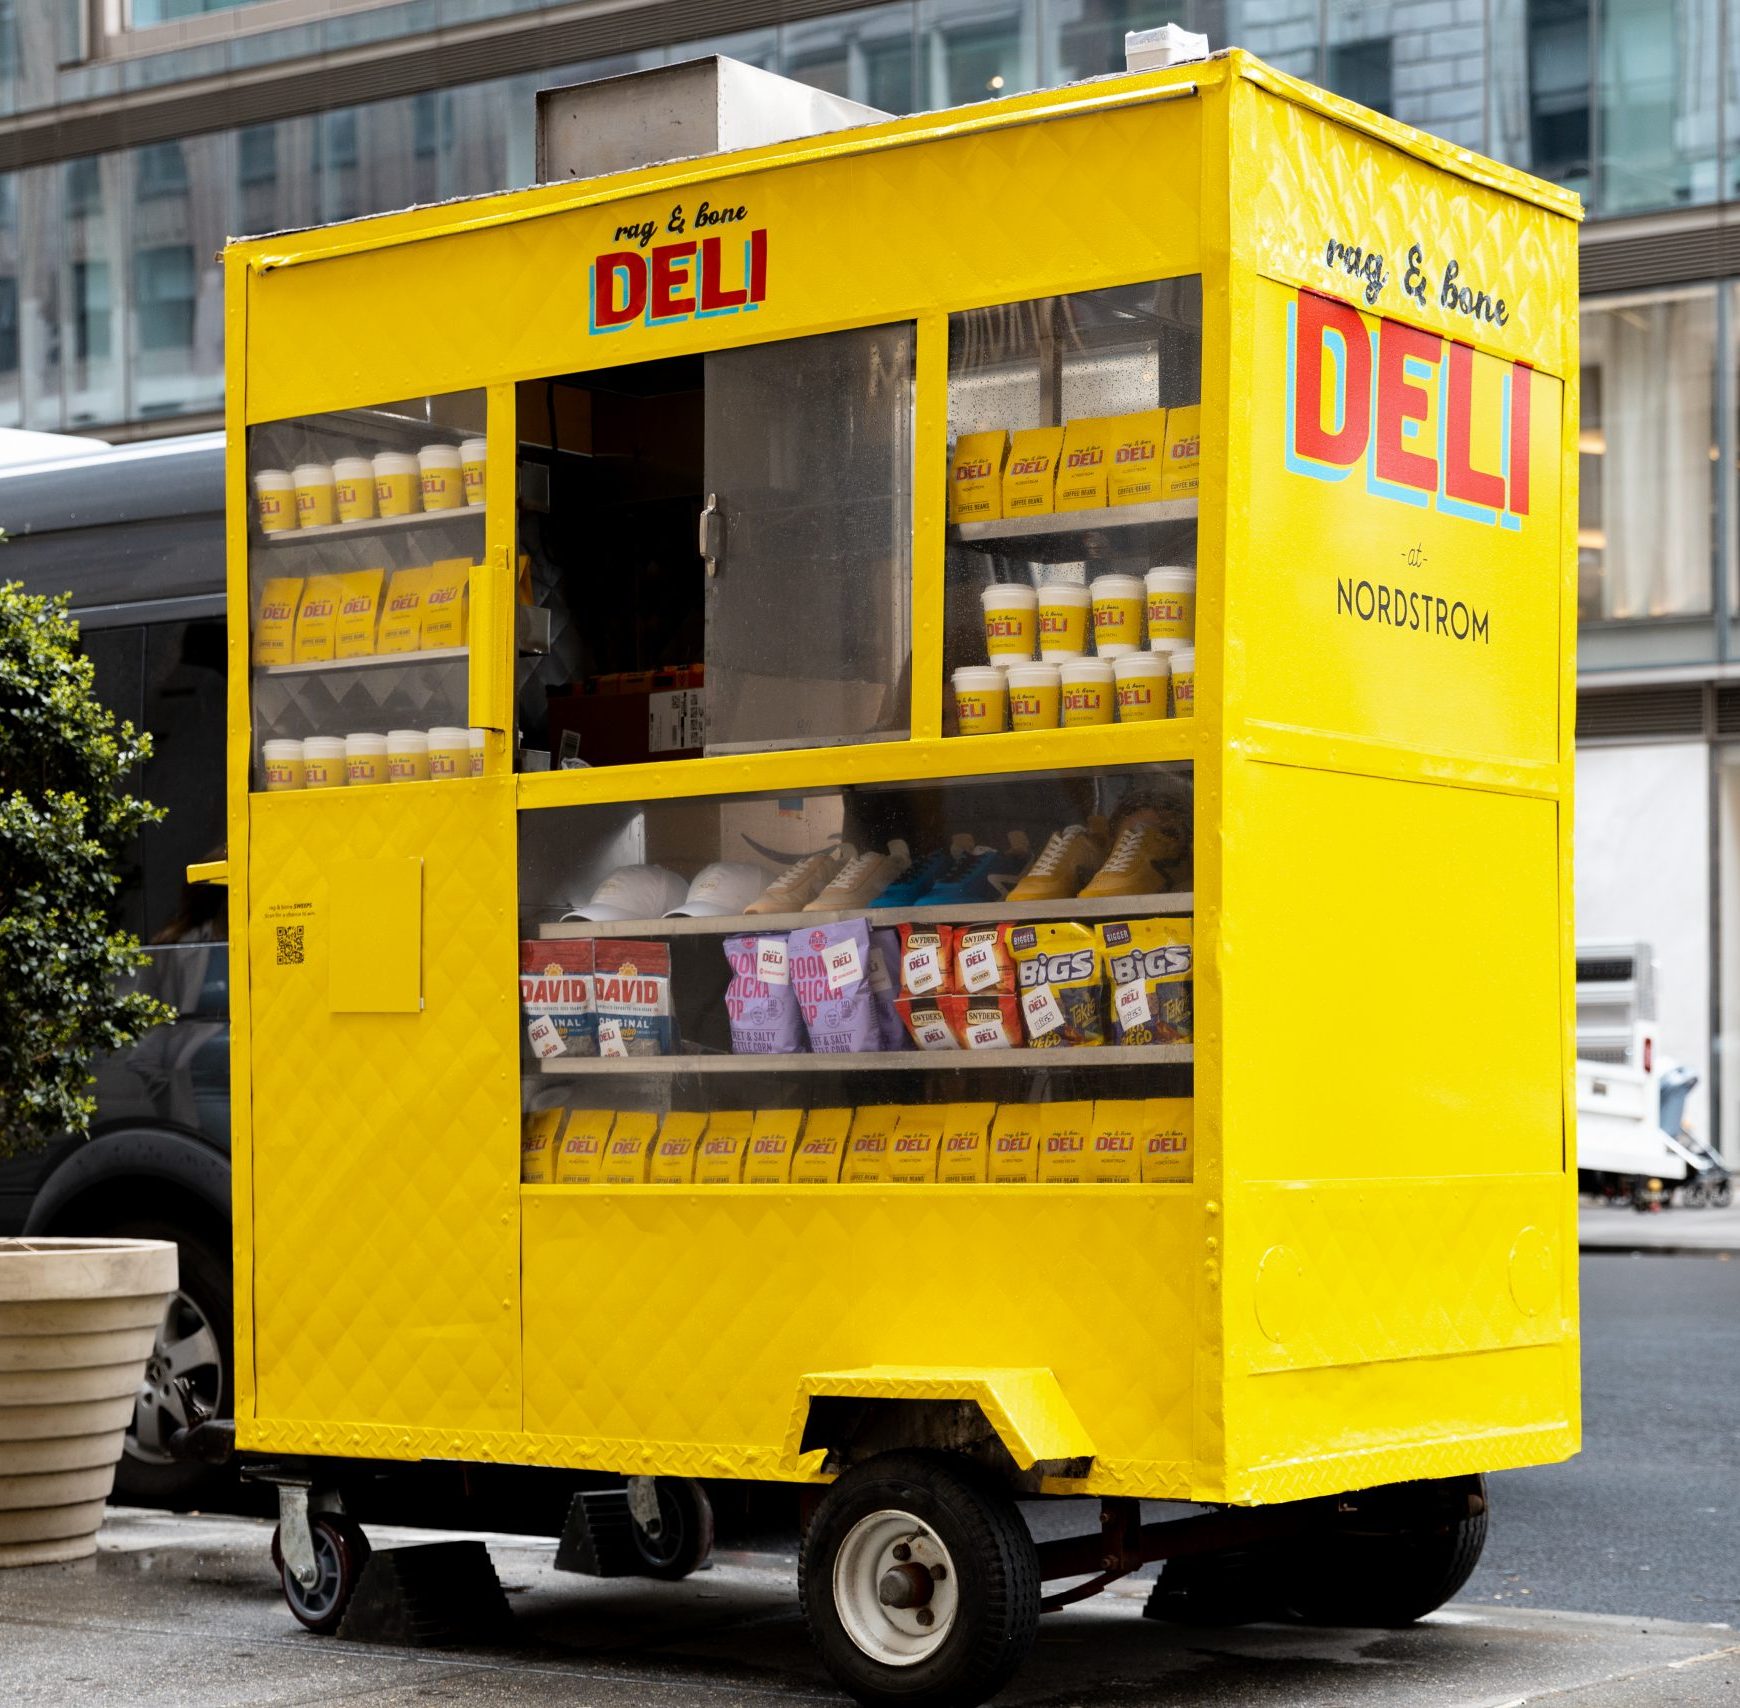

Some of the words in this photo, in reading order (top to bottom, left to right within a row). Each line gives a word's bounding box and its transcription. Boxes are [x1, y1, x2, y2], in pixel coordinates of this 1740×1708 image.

[614, 221, 658, 248] rag
[667, 205, 685, 234] &
[693, 202, 747, 230] bone
[589, 229, 767, 336] DELI
[1325, 237, 1389, 304] rag
[1401, 242, 1427, 308] &
[1441, 259, 1510, 327] bone
[1284, 285, 1535, 531] DELI
[1067, 449, 1104, 468] DELI
[1115, 444, 1155, 464] DELI
[956, 463, 992, 481] DELI
[1010, 459, 1049, 477] DELI
[464, 471, 483, 485] ELI
[338, 489, 356, 504] ELI
[377, 486, 392, 500] ELI
[260, 500, 280, 514] ELI
[298, 495, 315, 510] ELI
[389, 596, 420, 612] DELI
[428, 588, 458, 605] DELI
[262, 607, 291, 620] DELI
[303, 604, 333, 618] DELI
[343, 599, 371, 615] DELI
[1337, 577, 1489, 644] NORDSTROM
[1064, 695, 1100, 709] DELI
[305, 769, 327, 783] ELI
[964, 933, 996, 944] SNYDER'S
[1013, 935, 1035, 945] BIGGER
[1106, 932, 1129, 942] BIGGER
[762, 953, 782, 964] DELI
[833, 954, 852, 969] DELI
[909, 955, 930, 970] DELI
[965, 952, 987, 968] DELI
[520, 979, 586, 1003] DAVID
[595, 977, 658, 1004] DAVID
[794, 980, 843, 1004] HICKA
[1028, 996, 1048, 1014] DELI
[1121, 991, 1139, 1007] DELI
[727, 999, 744, 1021] OP
[599, 1017, 649, 1028] ORGINAL
[531, 1026, 549, 1041] DELI
[754, 1032, 776, 1042] SALTY
[830, 1033, 852, 1044] SALTY
[924, 1032, 945, 1043] DELI
[974, 1031, 998, 1043] DELI
[542, 1045, 557, 1057] DAVID
[565, 1140, 598, 1154] DELI
[611, 1141, 640, 1155] DELI
[659, 1143, 692, 1156] DELI
[704, 1141, 738, 1155] DELI
[754, 1140, 787, 1154] DELI
[802, 1142, 838, 1154] DELI
[853, 1137, 887, 1153] DELI
[894, 1138, 931, 1153] DELI
[946, 1136, 979, 1152] DELI
[996, 1136, 1031, 1153] DELI
[1047, 1136, 1084, 1152] DELI
[1094, 1137, 1134, 1152] DELI
[1148, 1137, 1187, 1154] DELI
